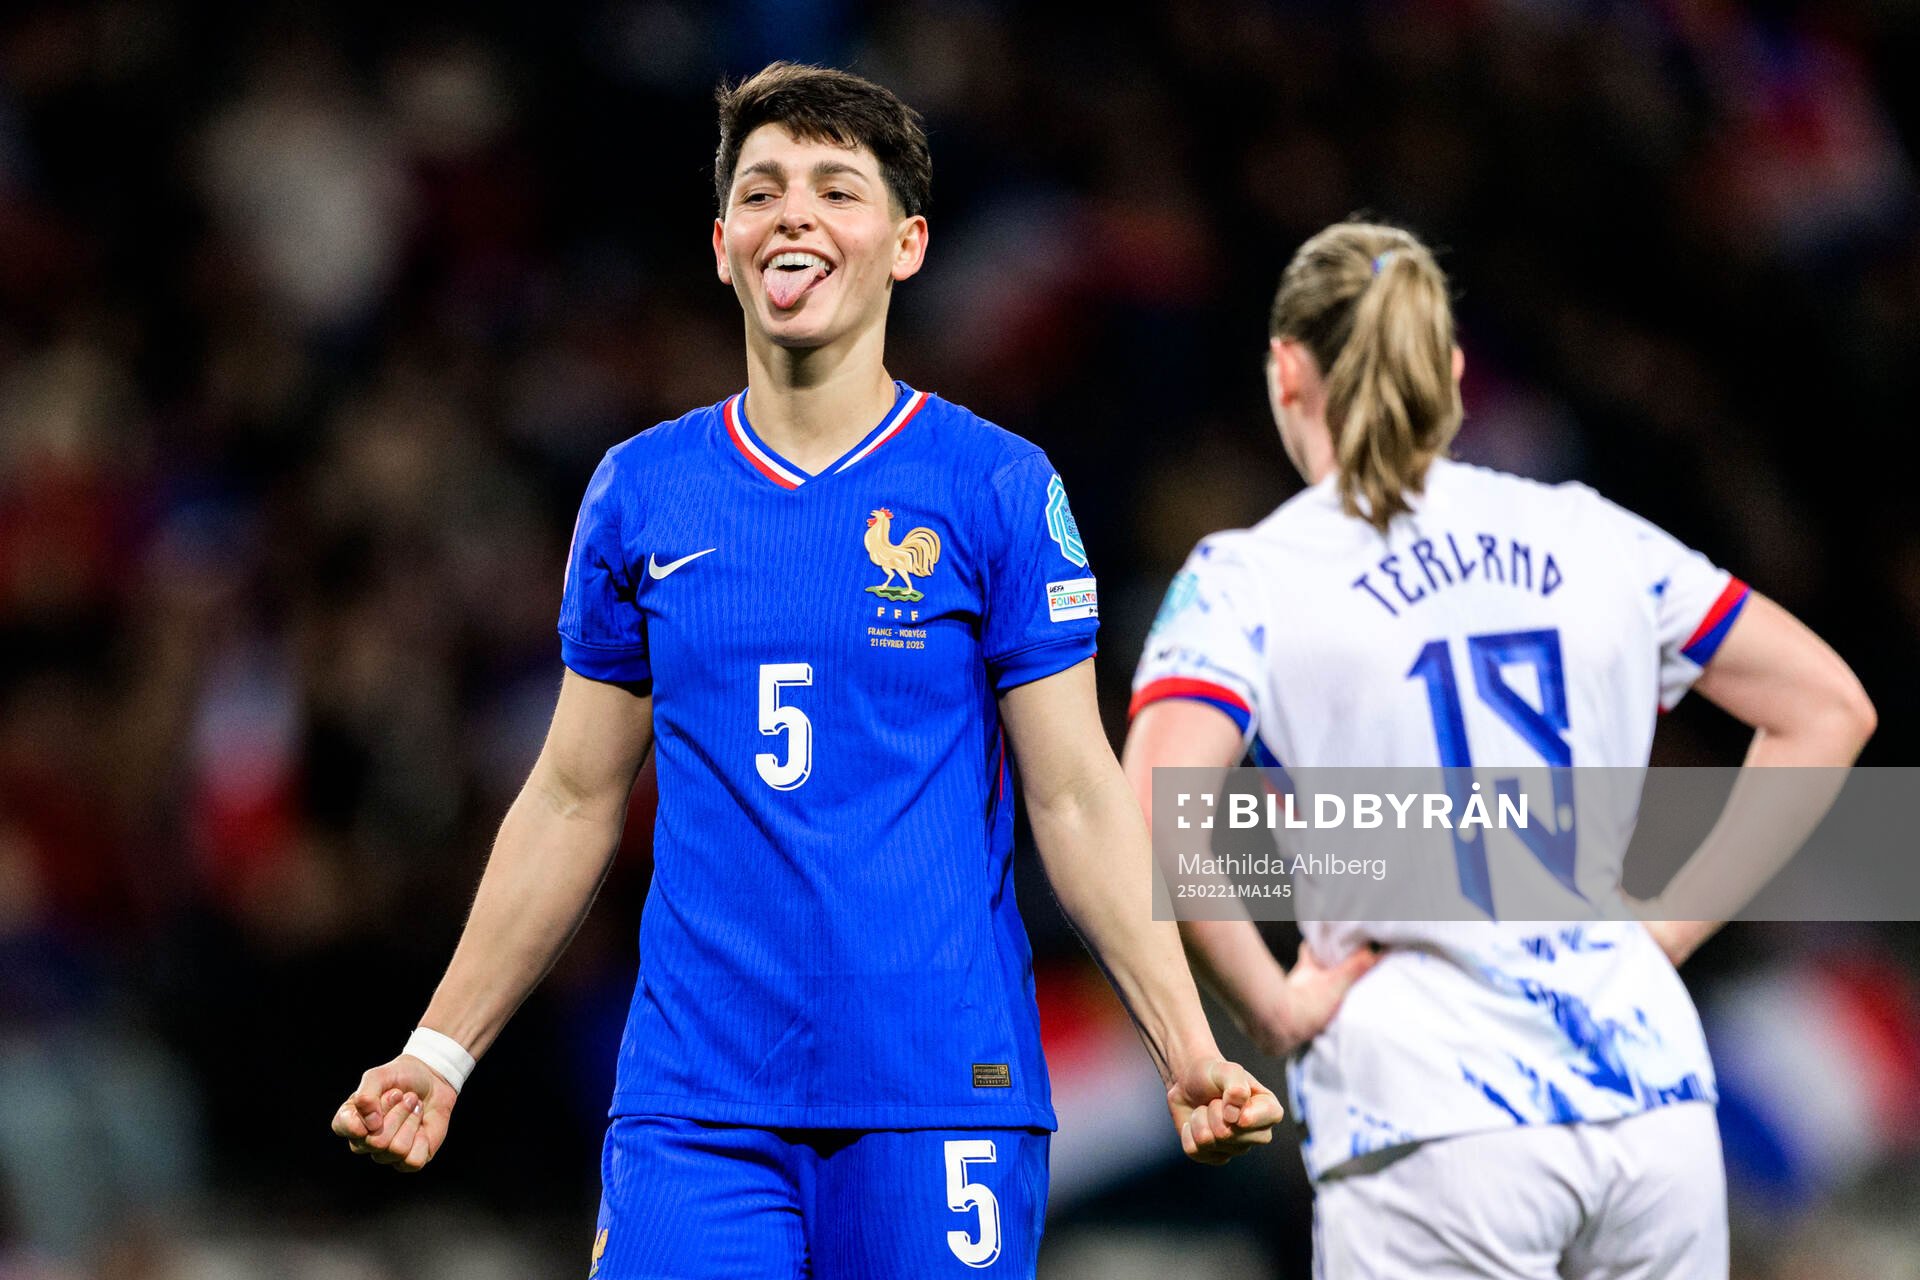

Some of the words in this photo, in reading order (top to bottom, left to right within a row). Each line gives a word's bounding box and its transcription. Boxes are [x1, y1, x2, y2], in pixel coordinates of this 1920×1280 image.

[1049, 585, 1065, 593] UEFA
[1351, 532, 1563, 617] TERLAND
[867, 626, 893, 637] FRANCE
[870, 637, 879, 647] 21
[905, 640, 925, 650] 2025
[756, 663, 812, 791] 5
[1405, 626, 1594, 924] 19
[944, 1139, 1002, 1269] 5
